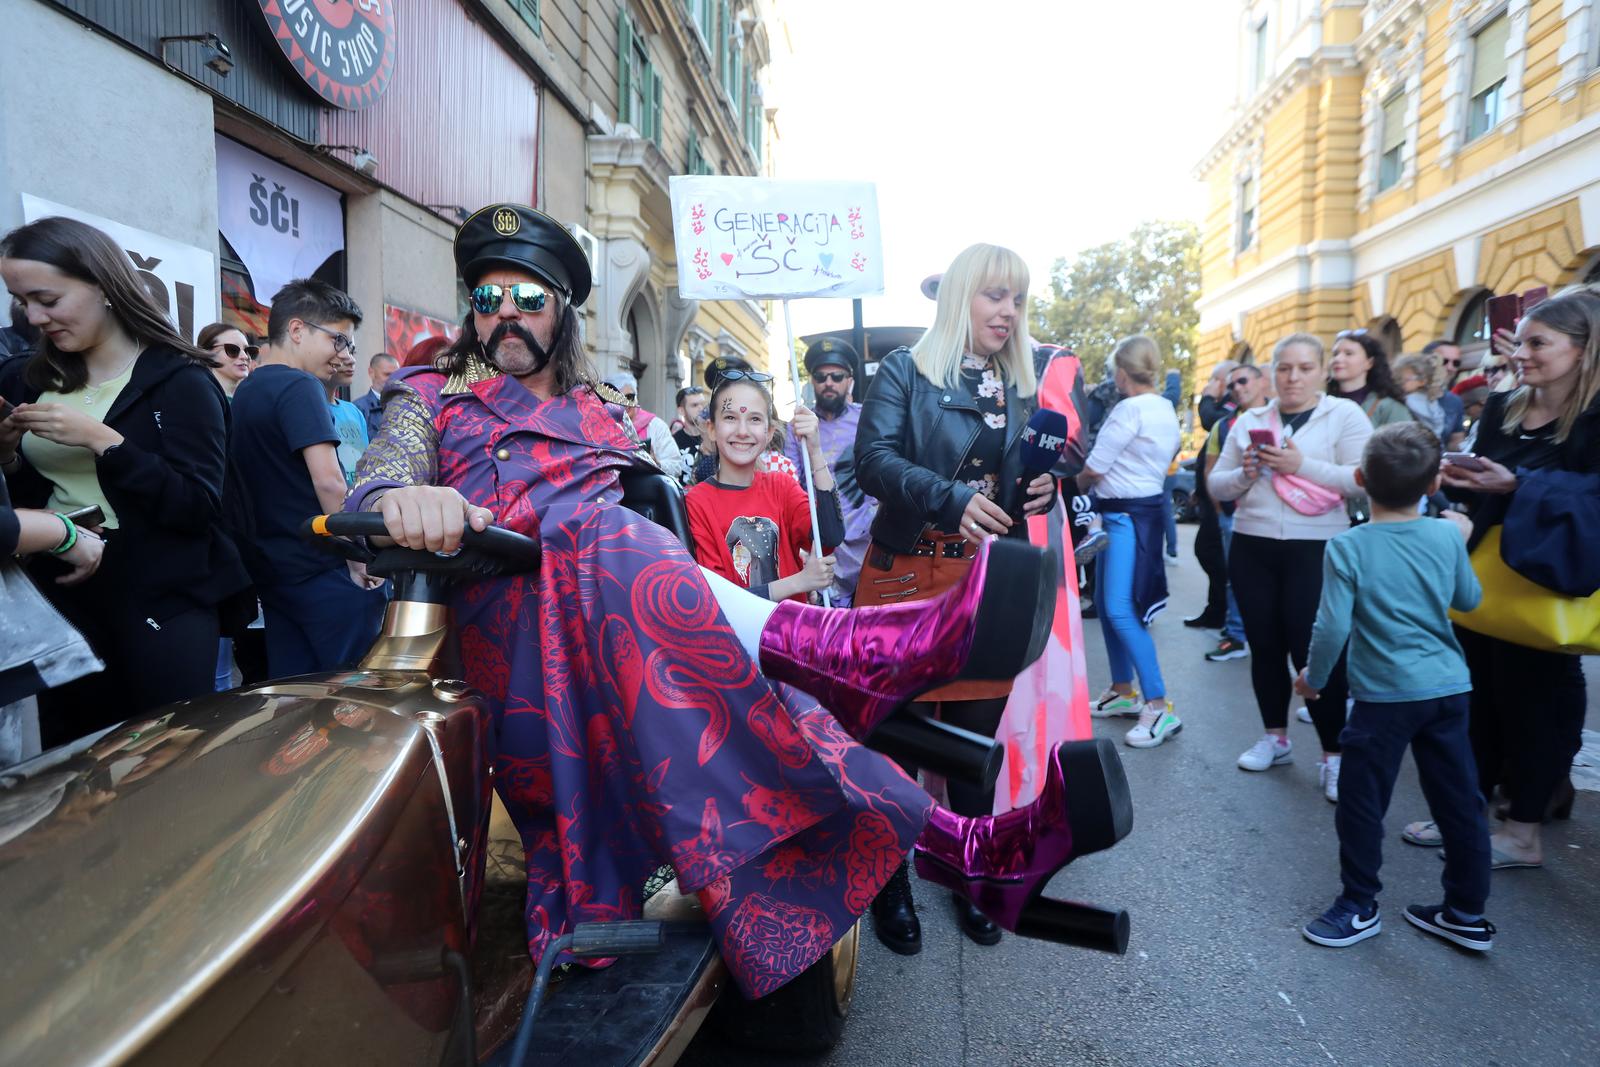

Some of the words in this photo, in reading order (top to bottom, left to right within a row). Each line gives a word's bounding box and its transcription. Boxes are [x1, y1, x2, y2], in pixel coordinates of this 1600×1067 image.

[338, 22, 378, 78] SHOP
[249, 172, 300, 238] ŠČ!
[497, 211, 516, 231] ŠČ!
[736, 232, 803, 278] ŠČ
[1038, 433, 1065, 450] HRT
